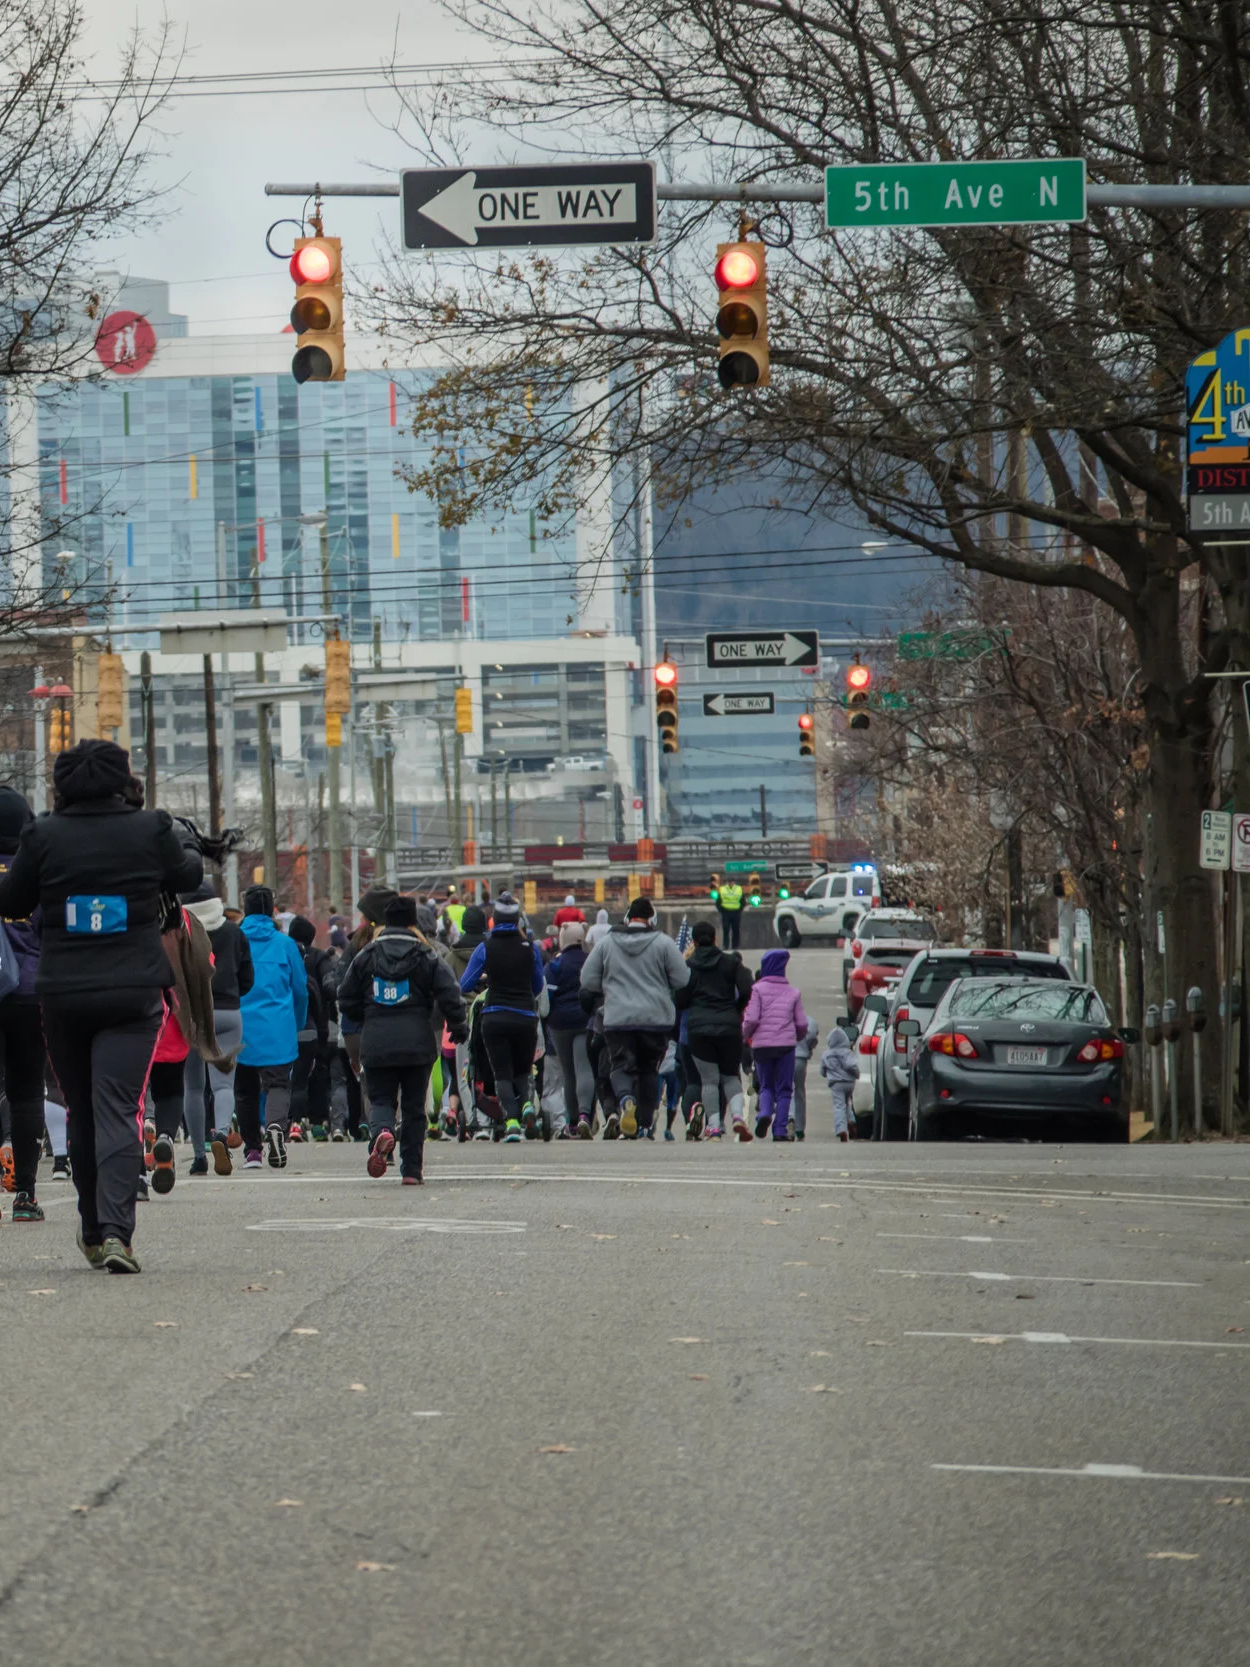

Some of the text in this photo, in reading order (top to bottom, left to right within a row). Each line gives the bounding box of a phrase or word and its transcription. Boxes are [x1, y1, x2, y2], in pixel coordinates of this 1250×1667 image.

[854, 175, 1058, 212] 5th Ave N
[479, 188, 624, 222] ONE WAY
[1190, 367, 1246, 440] 4th
[1202, 501, 1233, 526] 5th
[719, 642, 784, 657] ONE WAY
[724, 698, 766, 709] ONE WAY
[1214, 833, 1226, 841] AM
[91, 913, 102, 931] 8
[384, 987, 397, 999] 38
